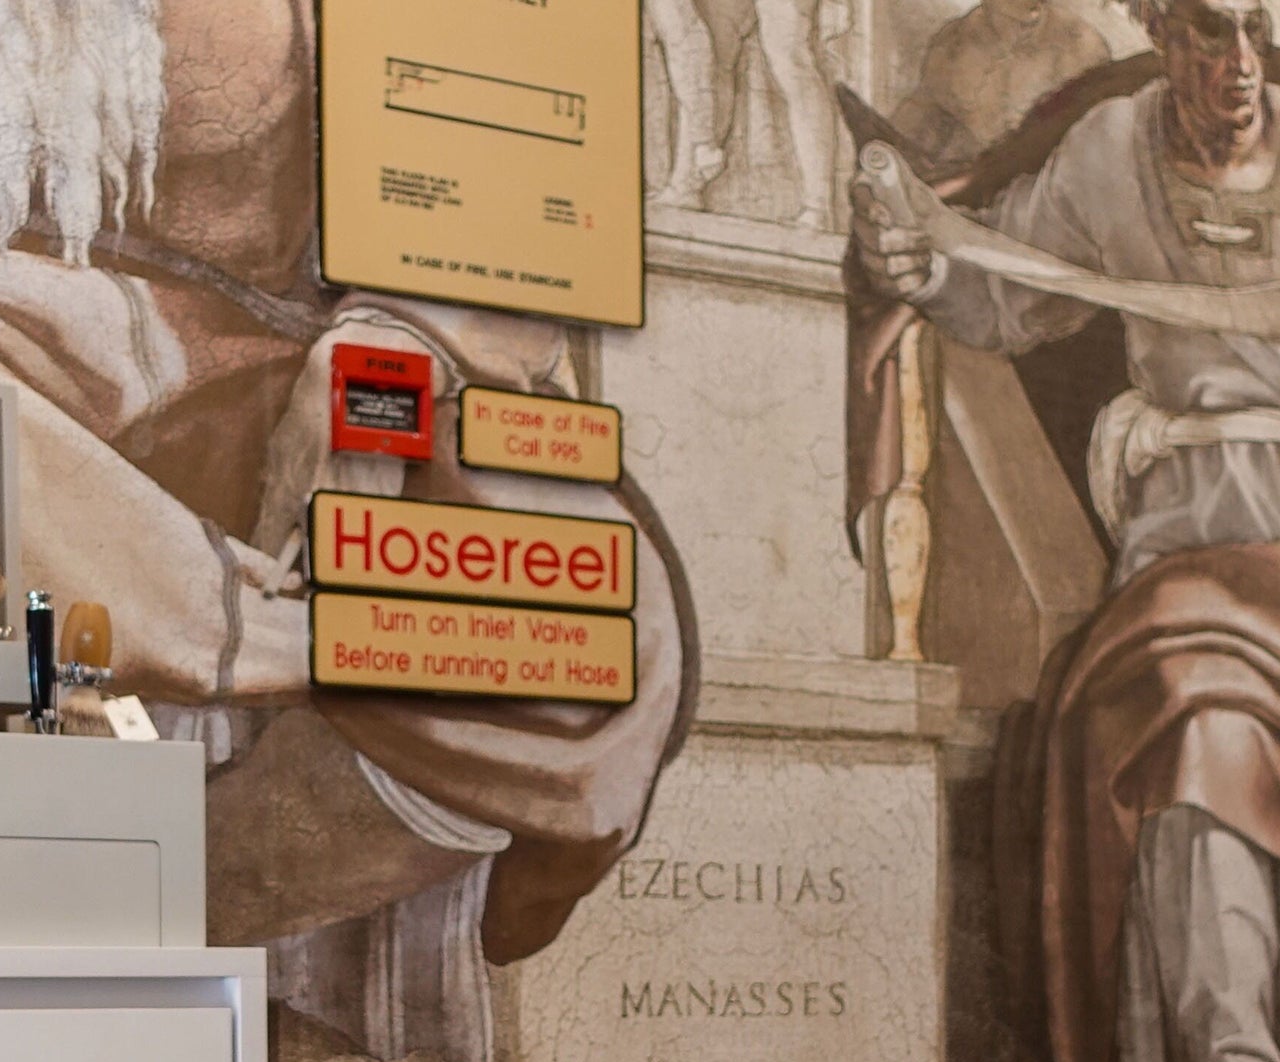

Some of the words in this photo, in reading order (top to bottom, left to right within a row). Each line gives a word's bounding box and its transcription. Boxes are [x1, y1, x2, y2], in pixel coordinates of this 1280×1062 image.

[417, 257, 443, 269] CASE
[449, 262, 461, 272] OF
[495, 269, 515, 280] USE
[366, 357, 406, 373] FIRE
[475, 402, 491, 420] In
[500, 410, 544, 428] case
[554, 415, 572, 431] of
[580, 415, 610, 437] Fire
[505, 435, 541, 457] Call
[549, 442, 582, 463] 995
[334, 508, 619, 593] Hosereel
[370, 605, 416, 634] Turn
[427, 614, 458, 636] on
[471, 614, 515, 639] Inlet
[527, 617, 588, 645] Valve
[334, 642, 410, 671] Before
[424, 652, 508, 685] running
[520, 660, 556, 681] out
[567, 661, 619, 687] Hose
[619, 859, 846, 903] EZECHIAS
[620, 979, 847, 1018] MANASSES
